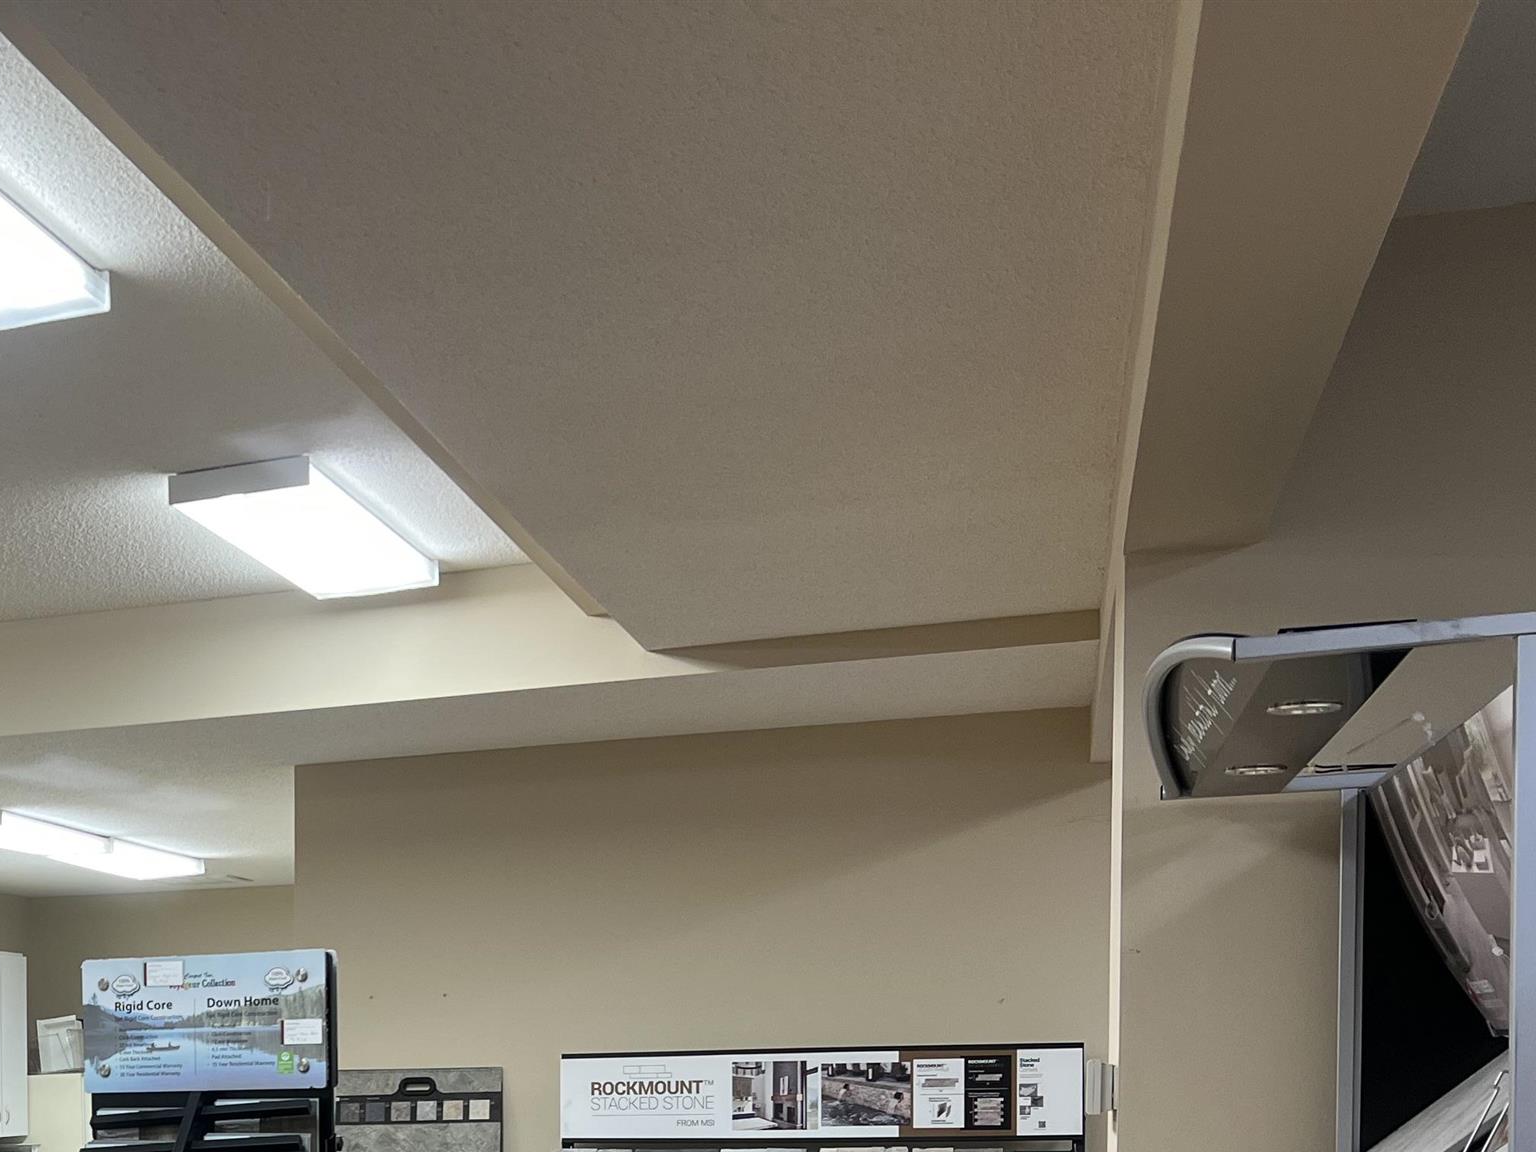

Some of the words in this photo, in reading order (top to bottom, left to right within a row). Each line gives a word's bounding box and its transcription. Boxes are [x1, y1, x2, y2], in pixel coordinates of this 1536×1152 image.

[202, 978, 236, 988] Collection
[114, 1000, 144, 1014] Rigid
[146, 1000, 173, 1012] Core
[207, 997, 241, 1008] Down
[244, 995, 280, 1007] Home
[590, 1096, 660, 1111] STACKED
[662, 1095, 715, 1111] STONE
[676, 1119, 700, 1127] FROM
[701, 1118, 715, 1127] MSI
